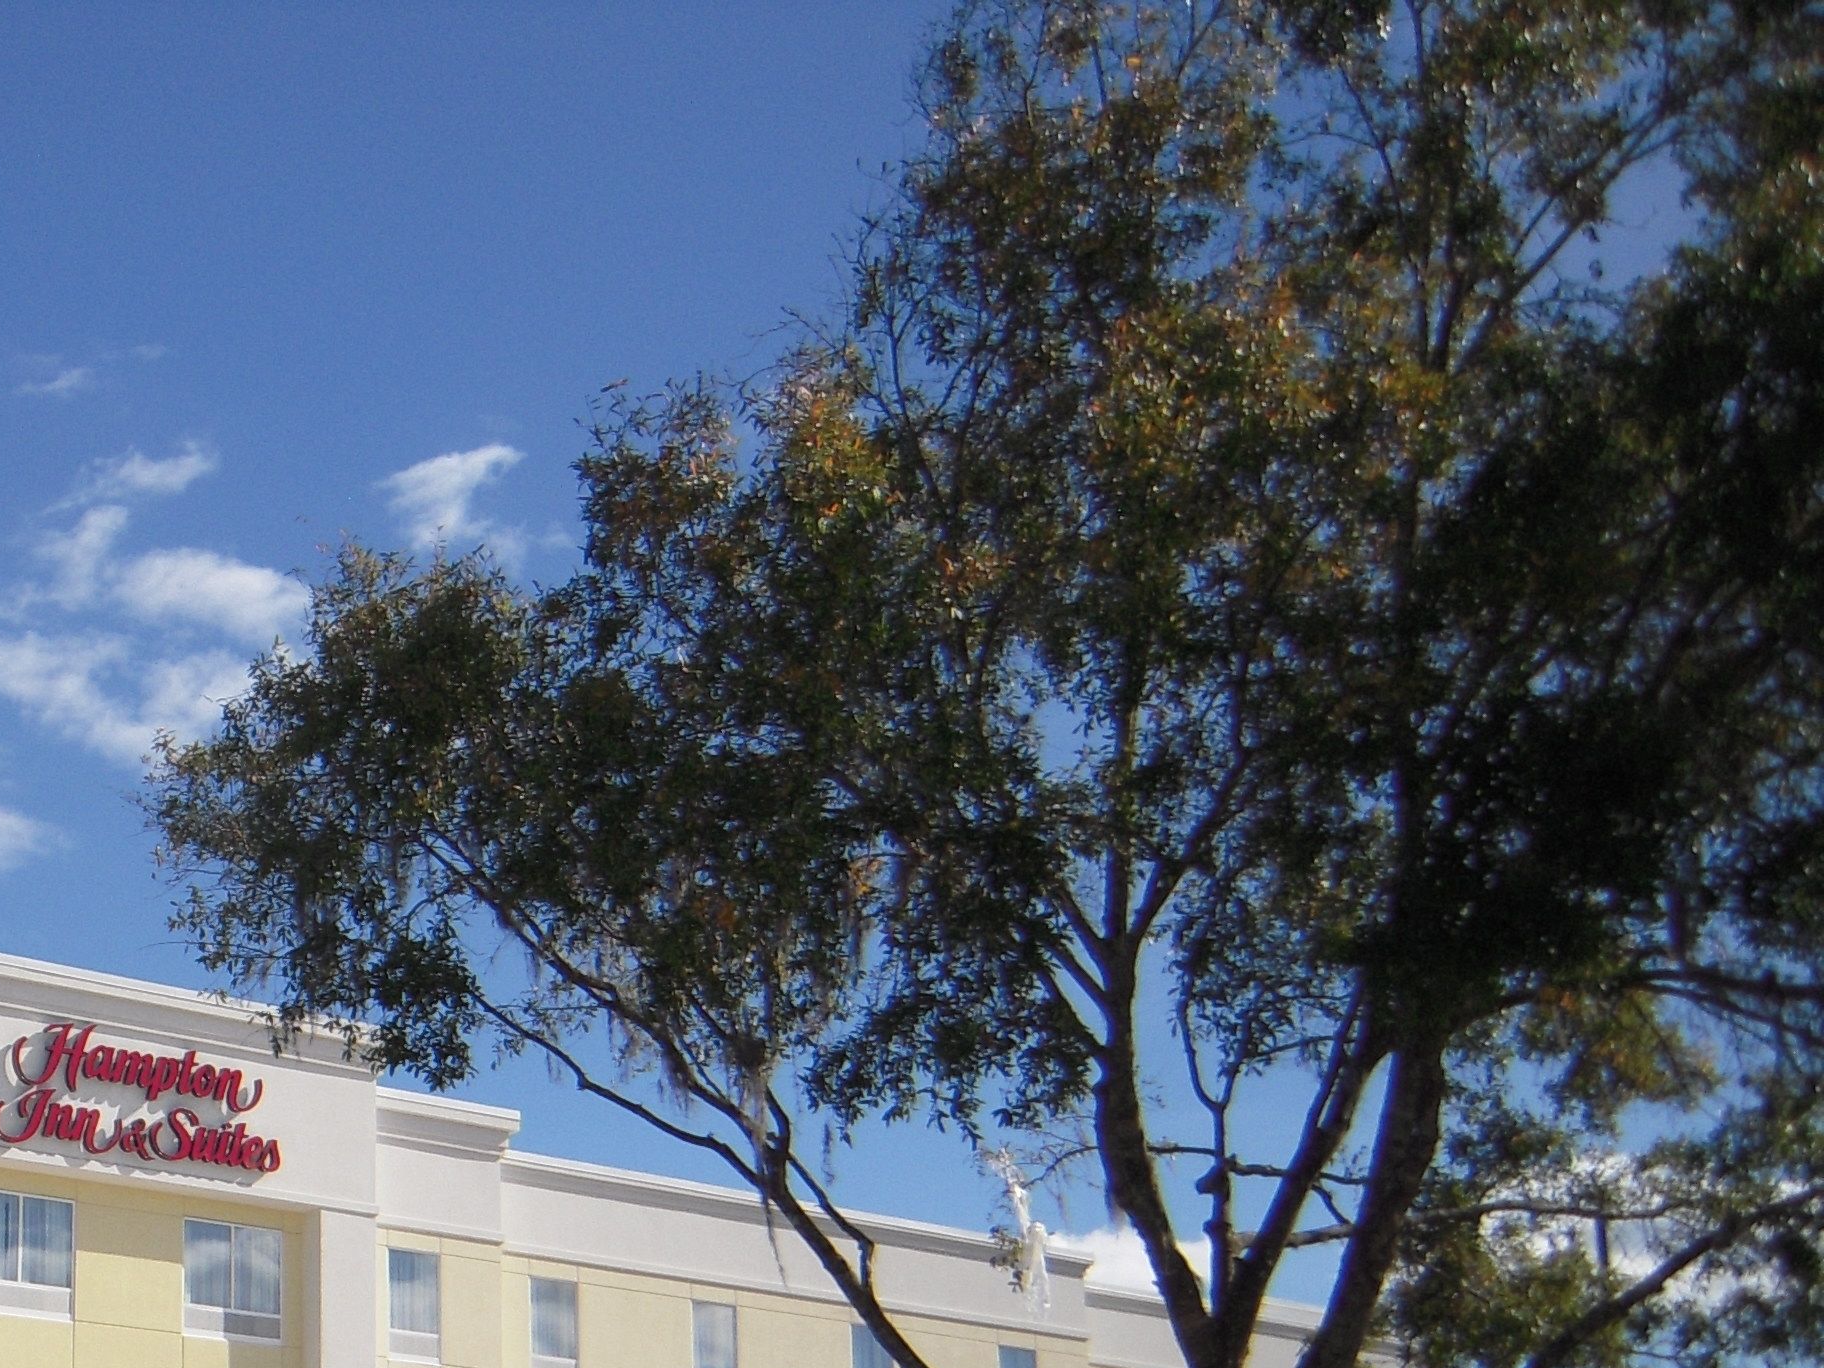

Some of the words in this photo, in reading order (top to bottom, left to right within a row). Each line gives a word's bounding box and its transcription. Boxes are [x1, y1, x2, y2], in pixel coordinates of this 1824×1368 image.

[12, 1023, 263, 1113] Hampton
[119, 1118, 154, 1161] &
[150, 1107, 282, 1172] Suites
